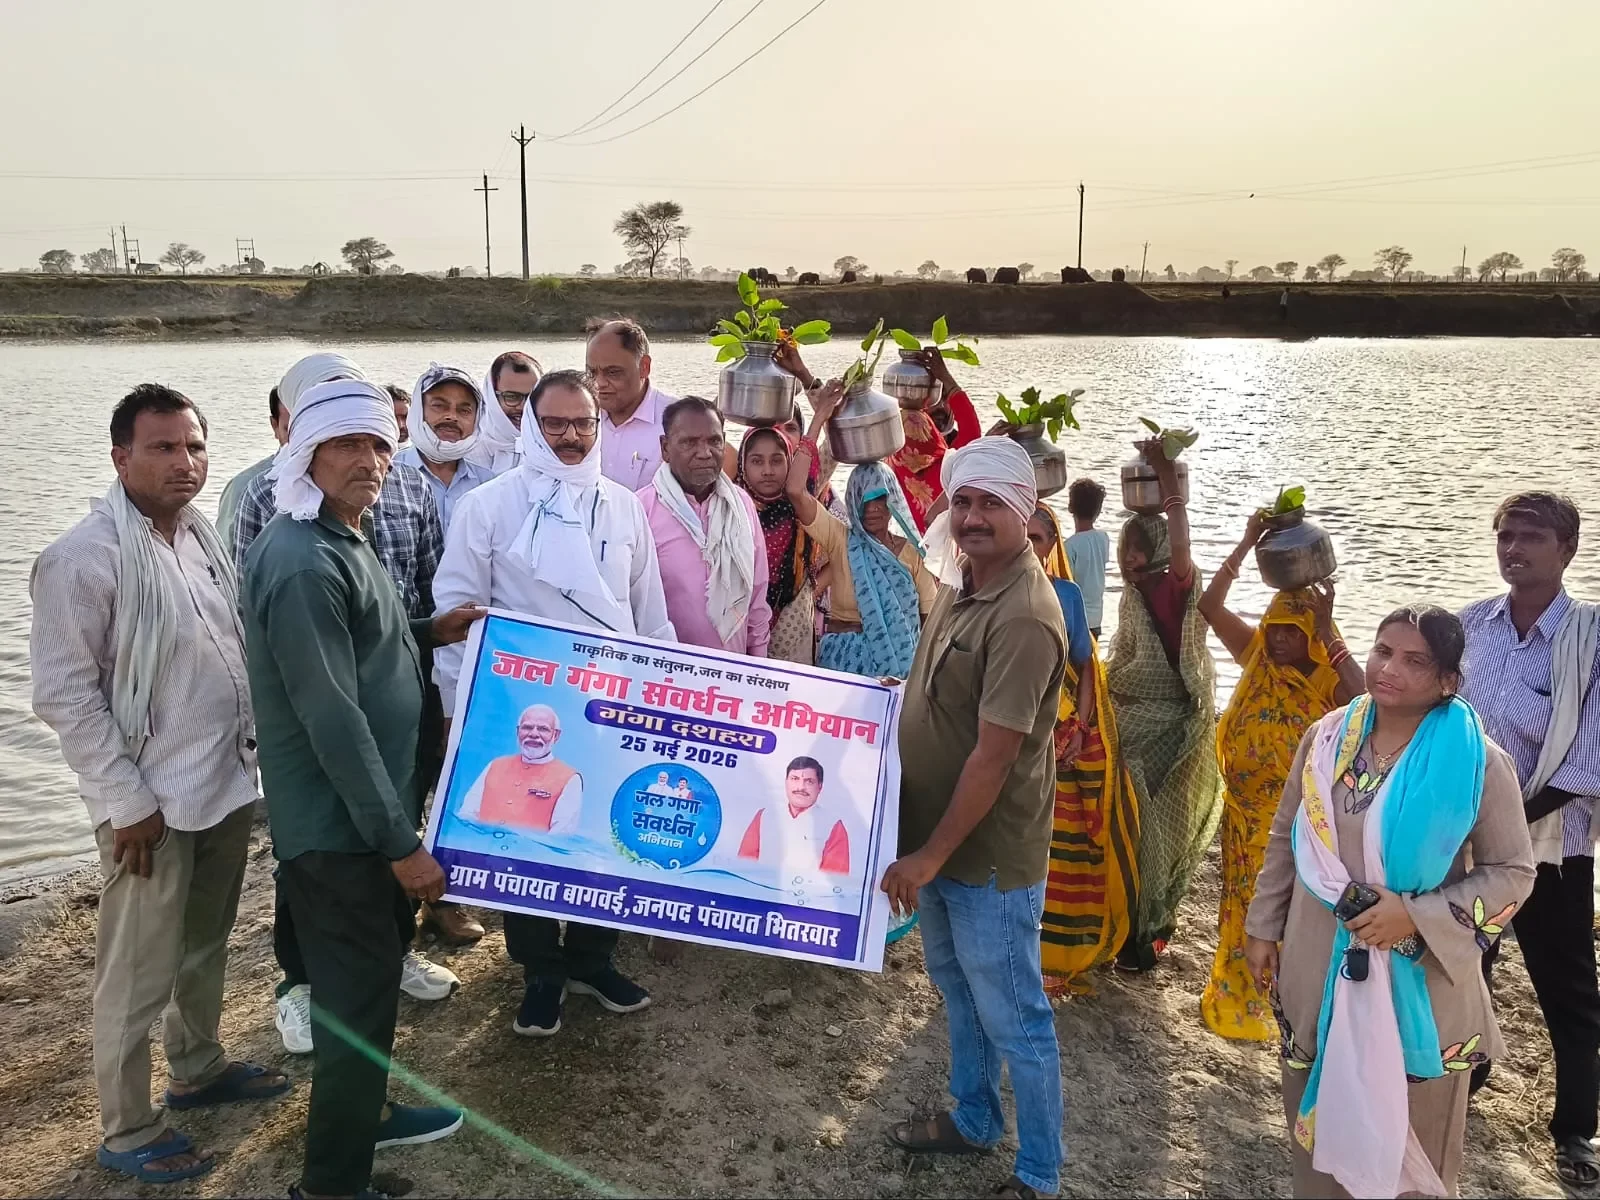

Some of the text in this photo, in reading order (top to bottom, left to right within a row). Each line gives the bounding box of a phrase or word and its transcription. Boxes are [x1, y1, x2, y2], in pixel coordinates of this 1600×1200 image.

[572, 642, 629, 662] प्राकृतिक
[632, 652, 650, 666] का
[726, 670, 742, 684] का
[746, 673, 790, 691] संरक्षण
[492, 650, 880, 745] जल गंगा संवर्धन अभियान
[599, 706, 765, 749] गंगा दशहरा
[620, 735, 738, 768] 25 मई 2026
[635, 790, 667, 808] जल
[637, 832, 684, 849] अभियान
[449, 863, 490, 889] ग्राम
[493, 866, 560, 901] पंचायत
[697, 900, 762, 935] पंचायत
[764, 911, 841, 947] भितरवार
